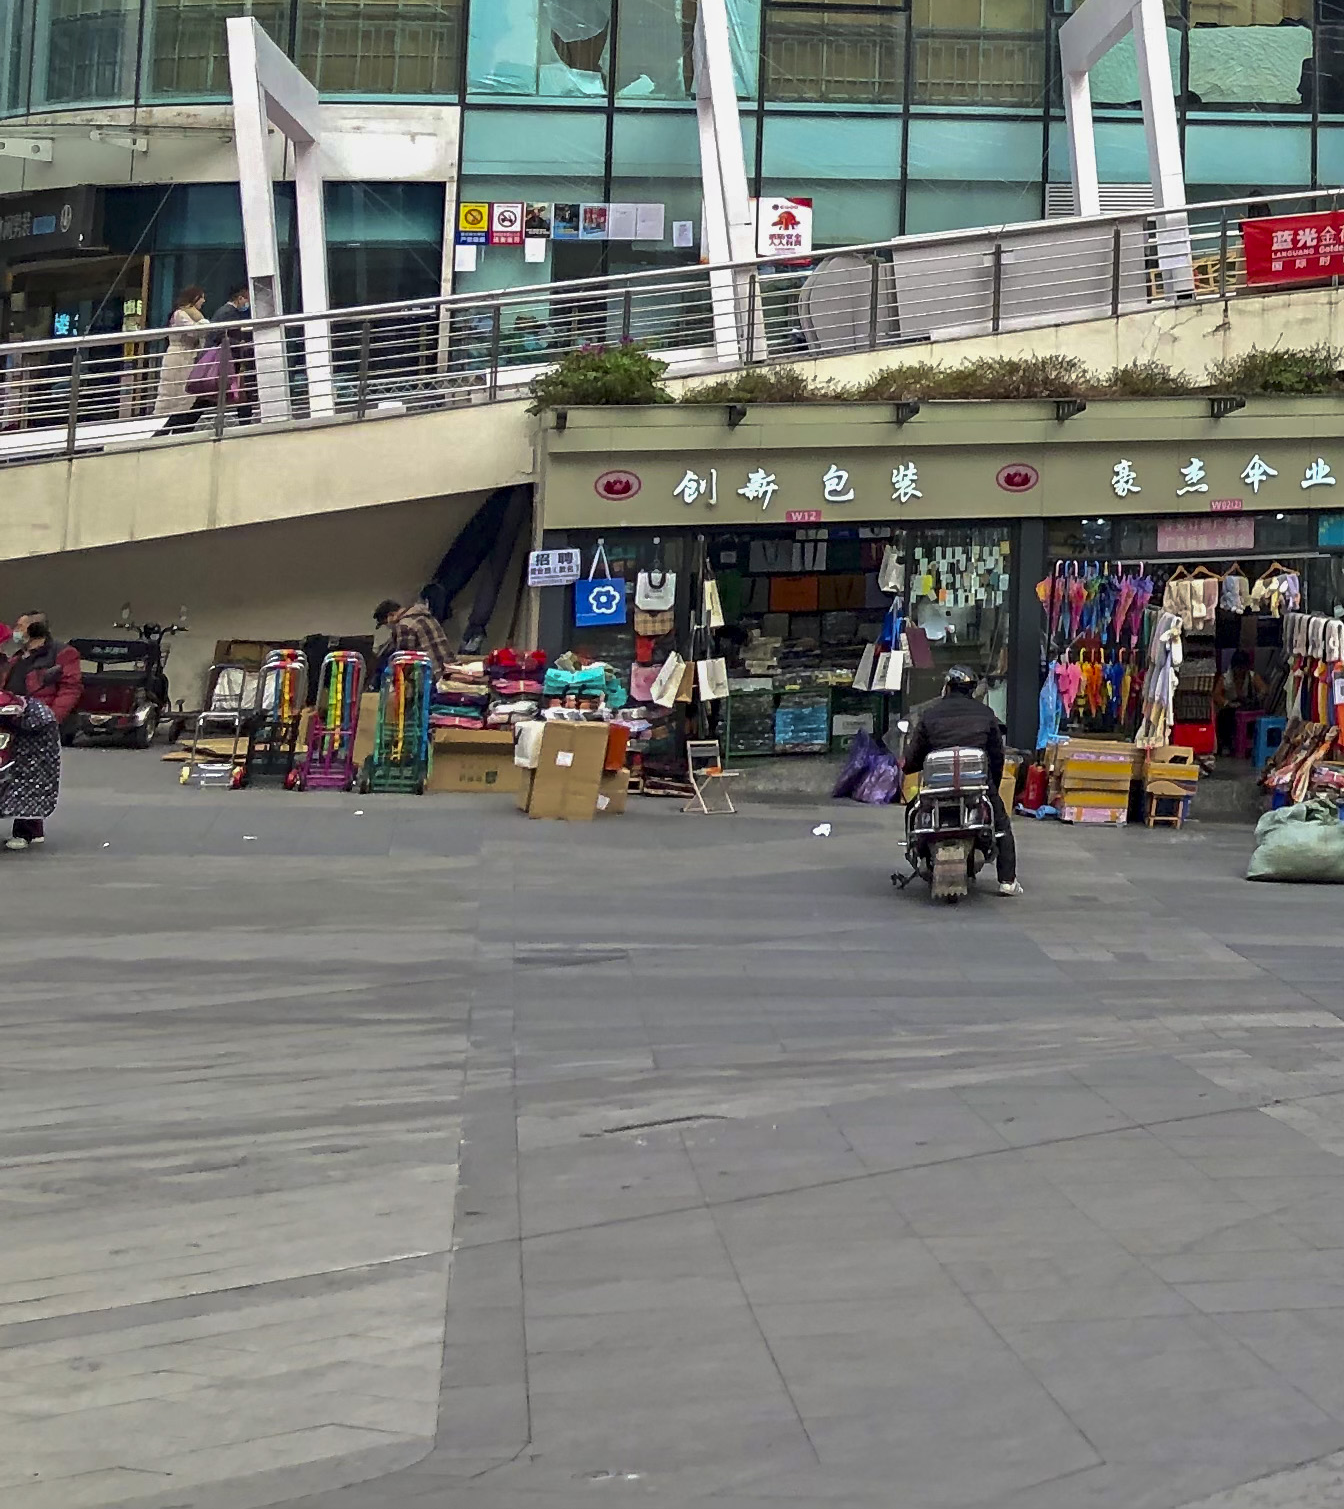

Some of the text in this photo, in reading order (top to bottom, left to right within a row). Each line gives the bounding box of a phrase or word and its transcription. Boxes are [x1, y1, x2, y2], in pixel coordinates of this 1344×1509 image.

[674, 461, 923, 510] 创新包装
[1110, 453, 1338, 496] 豪杰伞业
[791, 511, 817, 522] W12
[535, 552, 574, 567] 招聘
